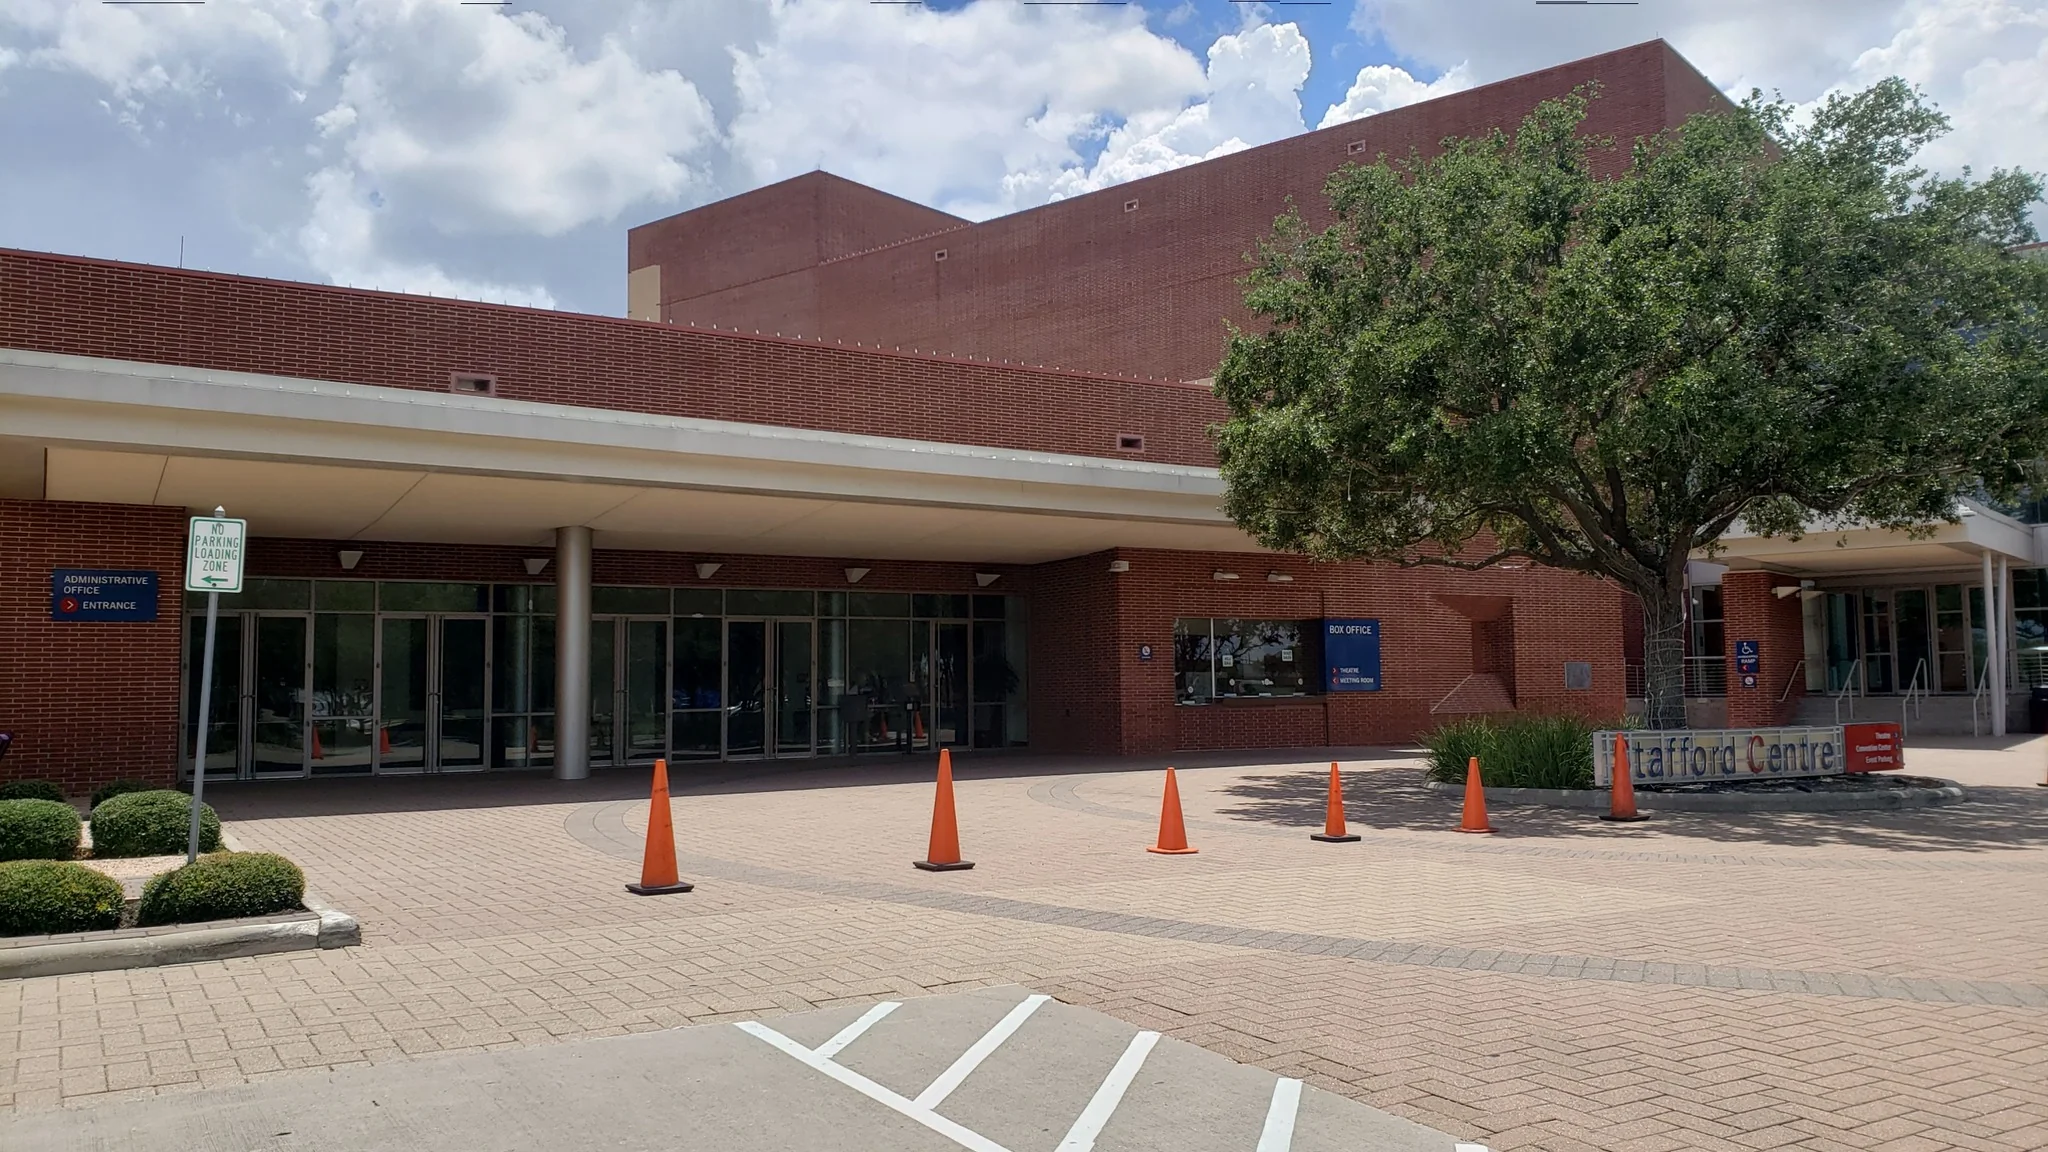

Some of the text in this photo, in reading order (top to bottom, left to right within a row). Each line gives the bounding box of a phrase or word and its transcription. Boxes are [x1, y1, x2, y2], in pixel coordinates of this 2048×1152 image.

[211, 523, 224, 535] NO
[195, 535, 239, 548] PARKING
[194, 547, 238, 560] LOADING
[202, 560, 229, 572] ZONE
[63, 575, 149, 585] ADMINISTRATIVE
[63, 586, 100, 595] OFFICE
[82, 601, 137, 610] ENTRANCE
[1329, 625, 1372, 635] BOX OFFICE
[1612, 735, 1834, 778] tafford Centre
